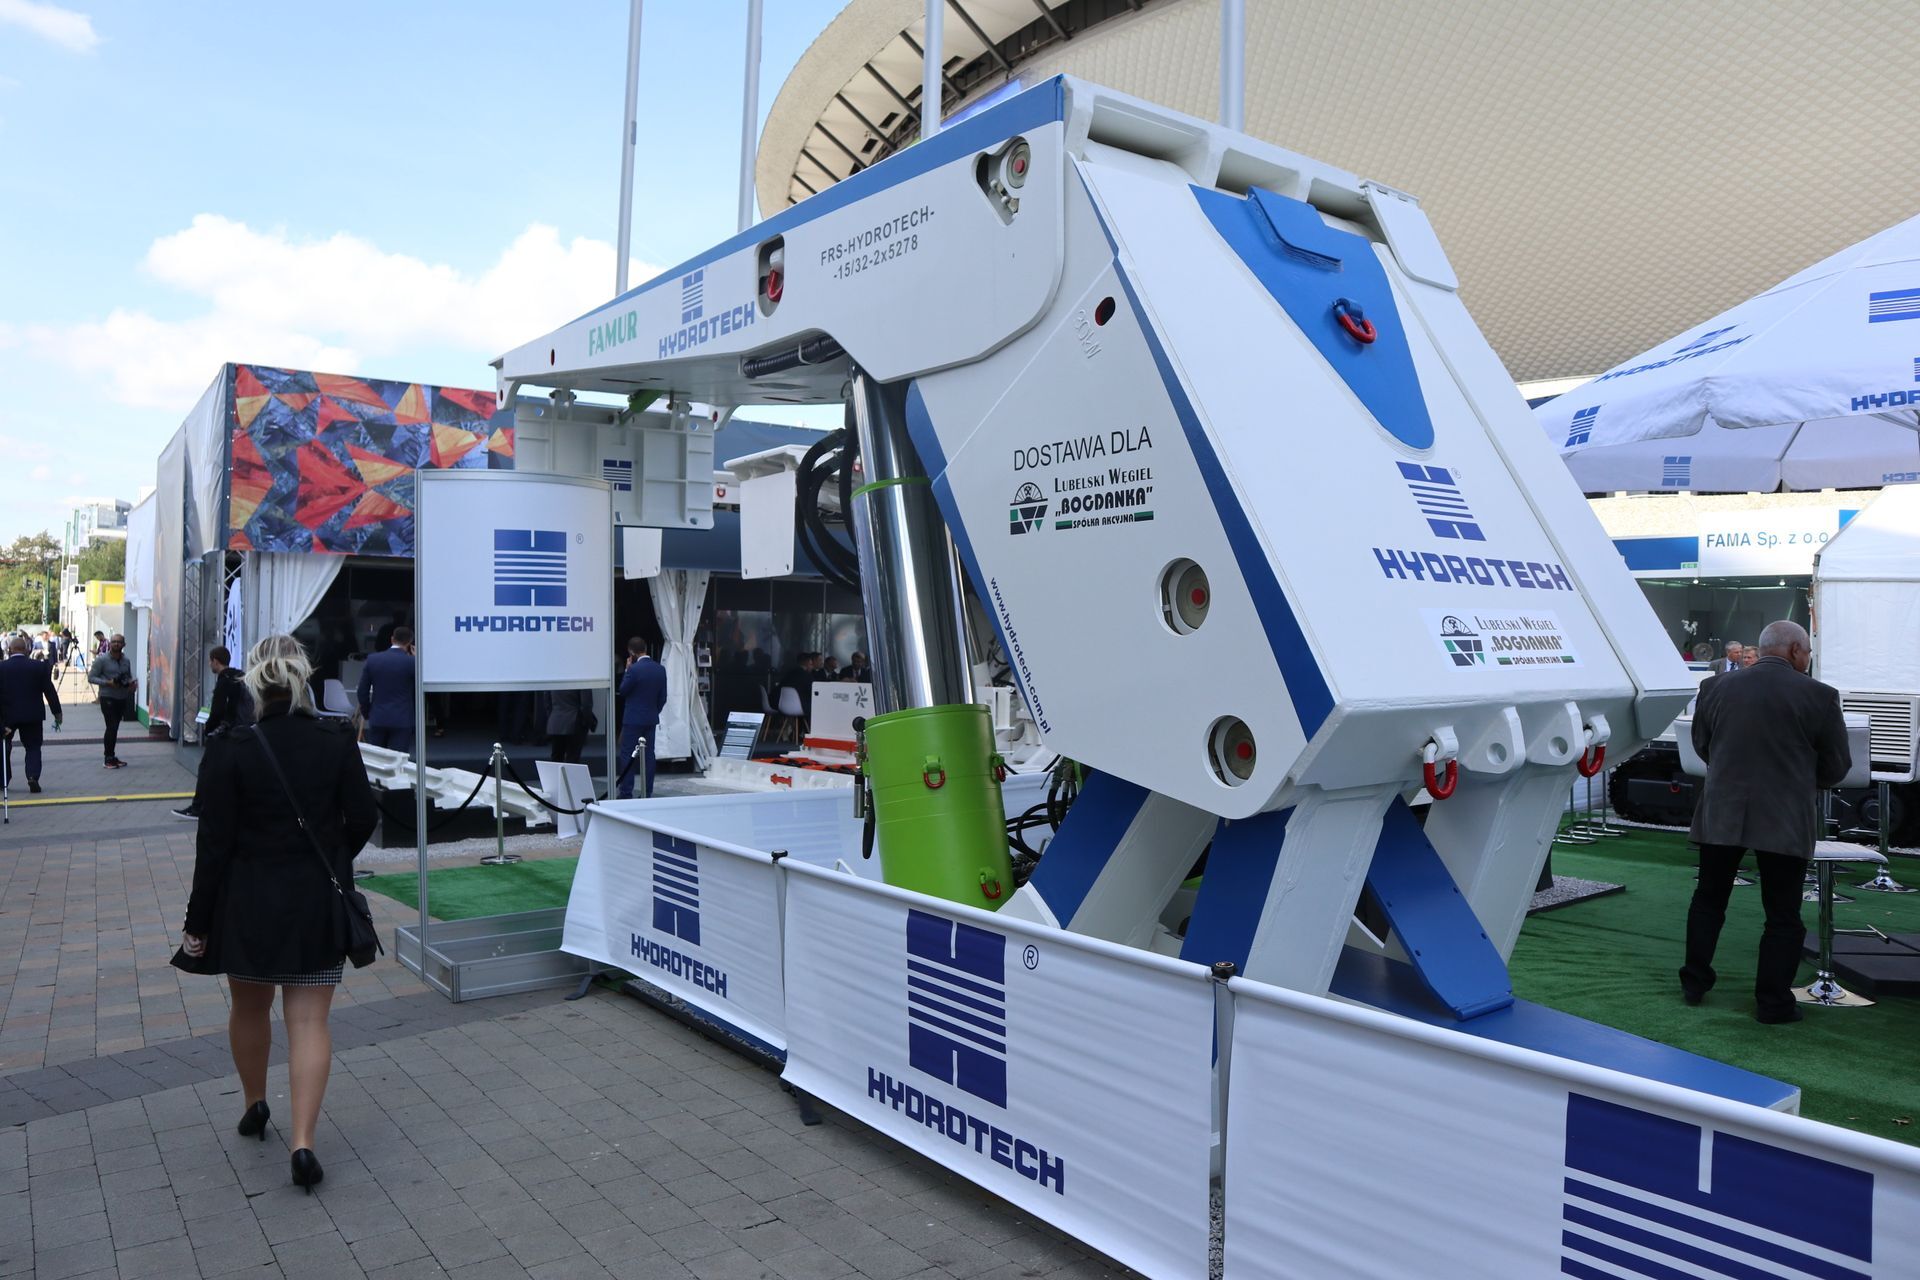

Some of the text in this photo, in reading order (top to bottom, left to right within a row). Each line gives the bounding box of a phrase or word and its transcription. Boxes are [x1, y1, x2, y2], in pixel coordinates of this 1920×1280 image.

[821, 205, 935, 266] FRS-HYDROTECH-
[833, 234, 918, 279] -15/32-2x5278
[589, 310, 638, 356] FAMUR
[659, 301, 755, 359] HYDROTECH
[1014, 426, 1152, 471] DOSTAWA DLA
[1102, 513, 1134, 526] AKCYJNA
[1706, 533, 1751, 548] FAMA
[1757, 531, 1782, 549] Sp.
[1788, 533, 1796, 544] z
[1372, 547, 1574, 591] HYDROTECH
[455, 616, 594, 632] HYDROTECH
[990, 577, 1051, 735] www.hydrotech.com.pl
[631, 933, 728, 999] HYDROTECH
[867, 1066, 1065, 1196] HYDROTECH
